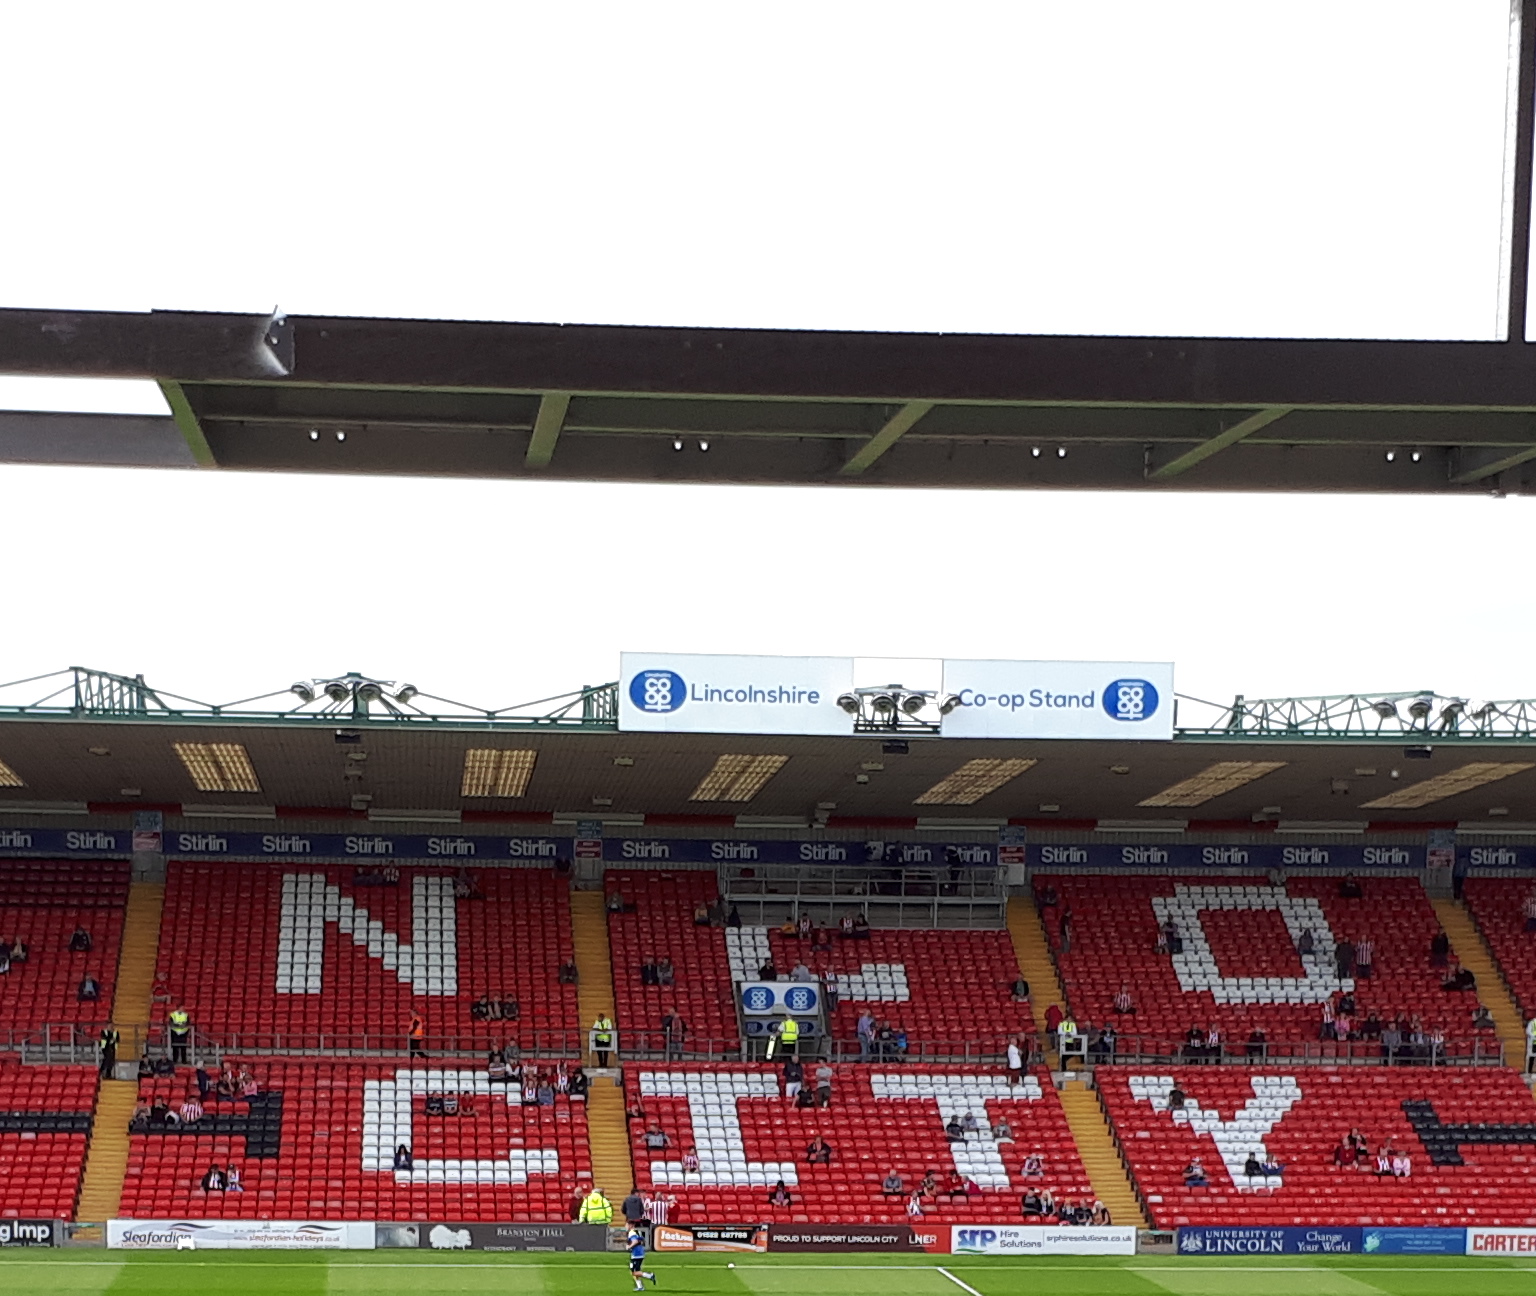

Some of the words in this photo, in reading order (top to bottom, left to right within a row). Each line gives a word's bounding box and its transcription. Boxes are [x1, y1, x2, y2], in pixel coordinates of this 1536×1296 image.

[690, 683, 820, 705] Lincolnshire
[960, 690, 1025, 711] Co-op
[1029, 689, 1095, 709] Stand
[66, 831, 115, 851] Stirlin
[178, 833, 228, 853] Stirlin
[261, 834, 311, 854] Stirlin
[345, 836, 394, 855] Stirlin
[427, 837, 475, 856] Stirlin
[509, 838, 557, 857] Stirlin
[621, 840, 669, 859] Stirlin
[710, 841, 758, 860] Stirlin
[799, 842, 846, 861] Stirlin
[1041, 847, 1088, 865] Stirlin
[1122, 847, 1168, 865] Stirlin
[1202, 847, 1249, 865] Stirlin
[1282, 848, 1329, 866] Stirlin
[1363, 848, 1410, 866] Stirlin
[1470, 848, 1517, 866] Stirlin
[13, 1219, 50, 1243] Imp
[957, 1228, 997, 1248] srp
[999, 1229, 1019, 1239] Hire
[1045, 1233, 1132, 1244] srphiresolutions.co.uk
[1205, 1230, 1268, 1239] UNIVERSITY
[1269, 1230, 1284, 1239] OF
[1305, 1230, 1343, 1244] Change
[772, 1234, 800, 1244] PROUD
[800, 1234, 812, 1244] TO
[812, 1234, 847, 1244] SUPPORT
[847, 1234, 880, 1245] LINCOLN
[881, 1234, 898, 1245] CITY
[908, 1233, 938, 1246] LNER
[999, 1239, 1042, 1249] Solutions
[1205, 1238, 1284, 1253] LINCOLN
[1297, 1241, 1319, 1253] Your
[1321, 1241, 1351, 1253] World
